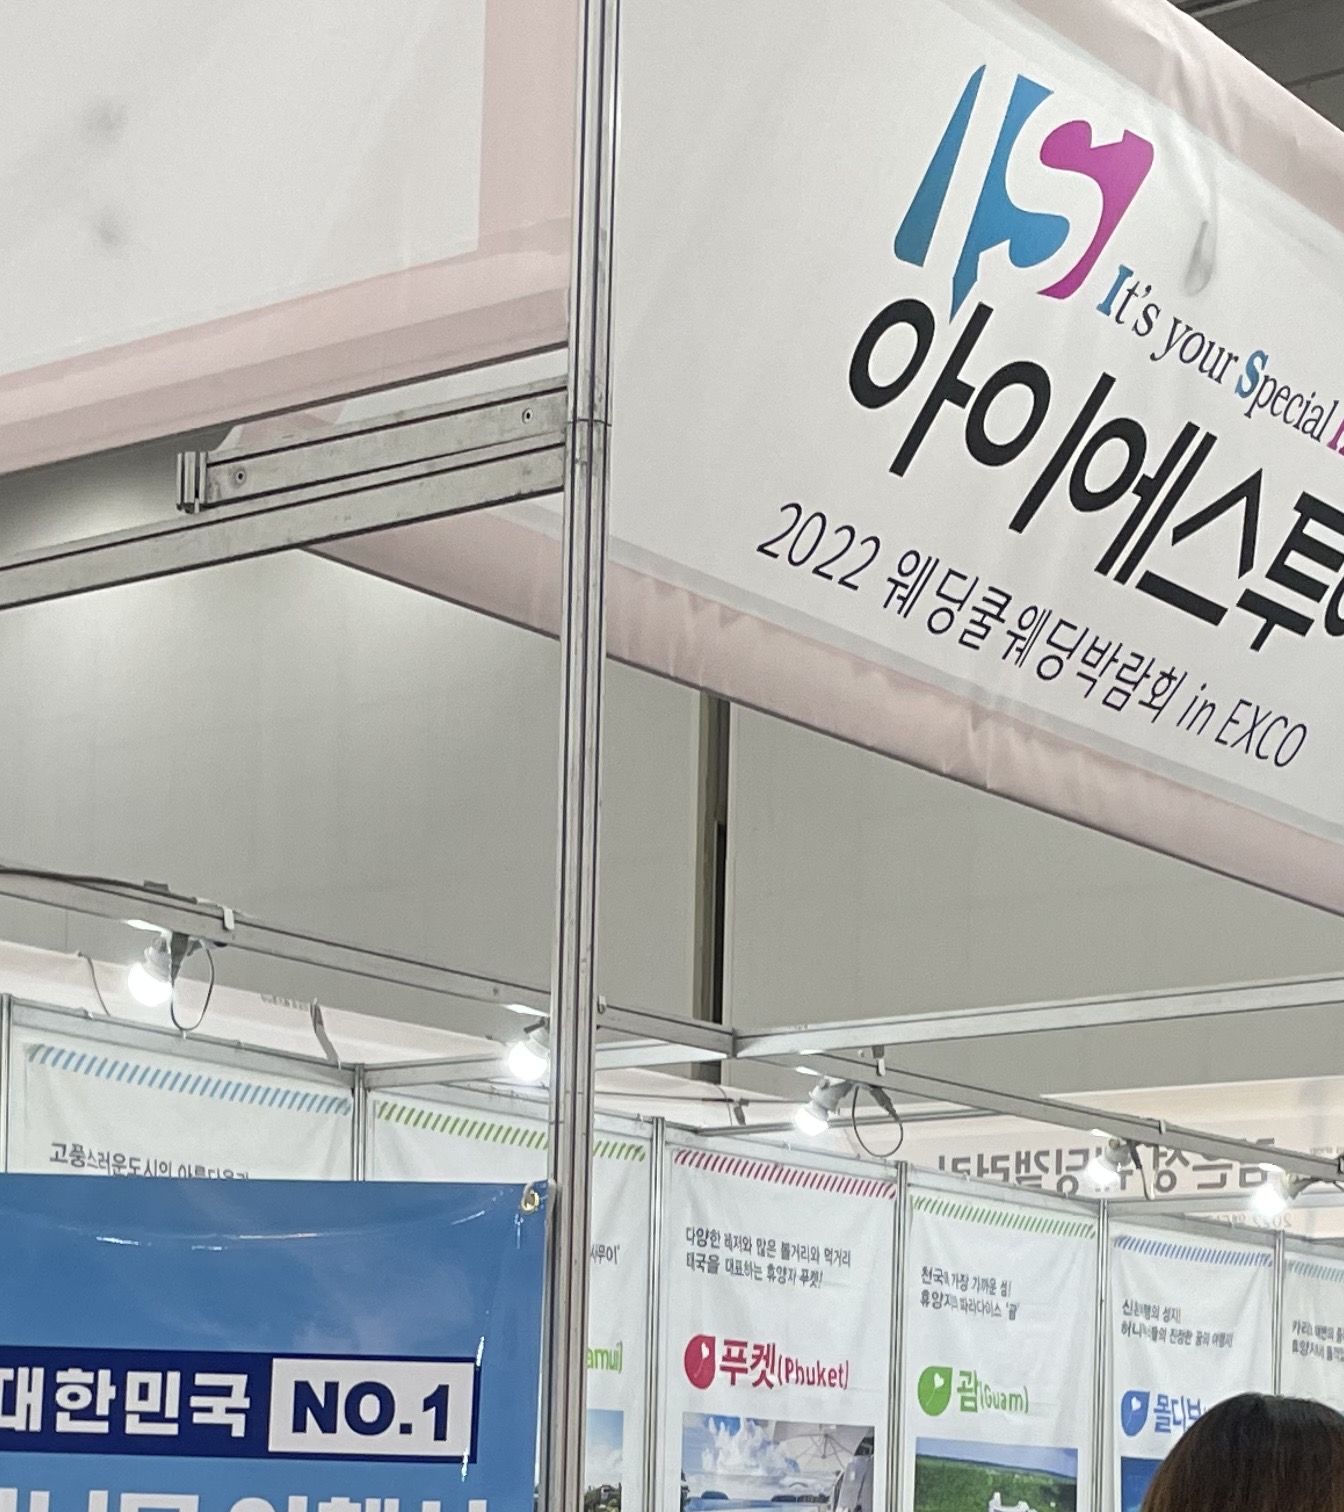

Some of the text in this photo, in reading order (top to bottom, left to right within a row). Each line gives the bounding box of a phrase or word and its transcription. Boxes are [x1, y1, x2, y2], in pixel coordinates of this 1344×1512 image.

[1096, 264, 1161, 338] It's
[1150, 317, 1239, 385] your
[1234, 350, 1340, 444] Special
[756, 502, 1309, 768] 2022 웨딩쿨웨딩박람회 in EXCO
[686, 1227, 721, 1249] 다양한
[756, 1238, 776, 1258] 많은
[781, 1241, 820, 1264] 볼거리와
[824, 1247, 851, 1268] 먹거리
[686, 1251, 720, 1274] 태국을
[725, 1257, 763, 1281] 대표하는
[767, 1263, 797, 1286] 휴양지
[951, 1273, 969, 1292] 가장
[719, 1339, 849, 1390] 푸켓(Phuket)
[291, 1381, 451, 1442] NO.1
[957, 1369, 1028, 1414] 괌(Guam)
[1153, 1393, 1210, 1433] 몰디브
